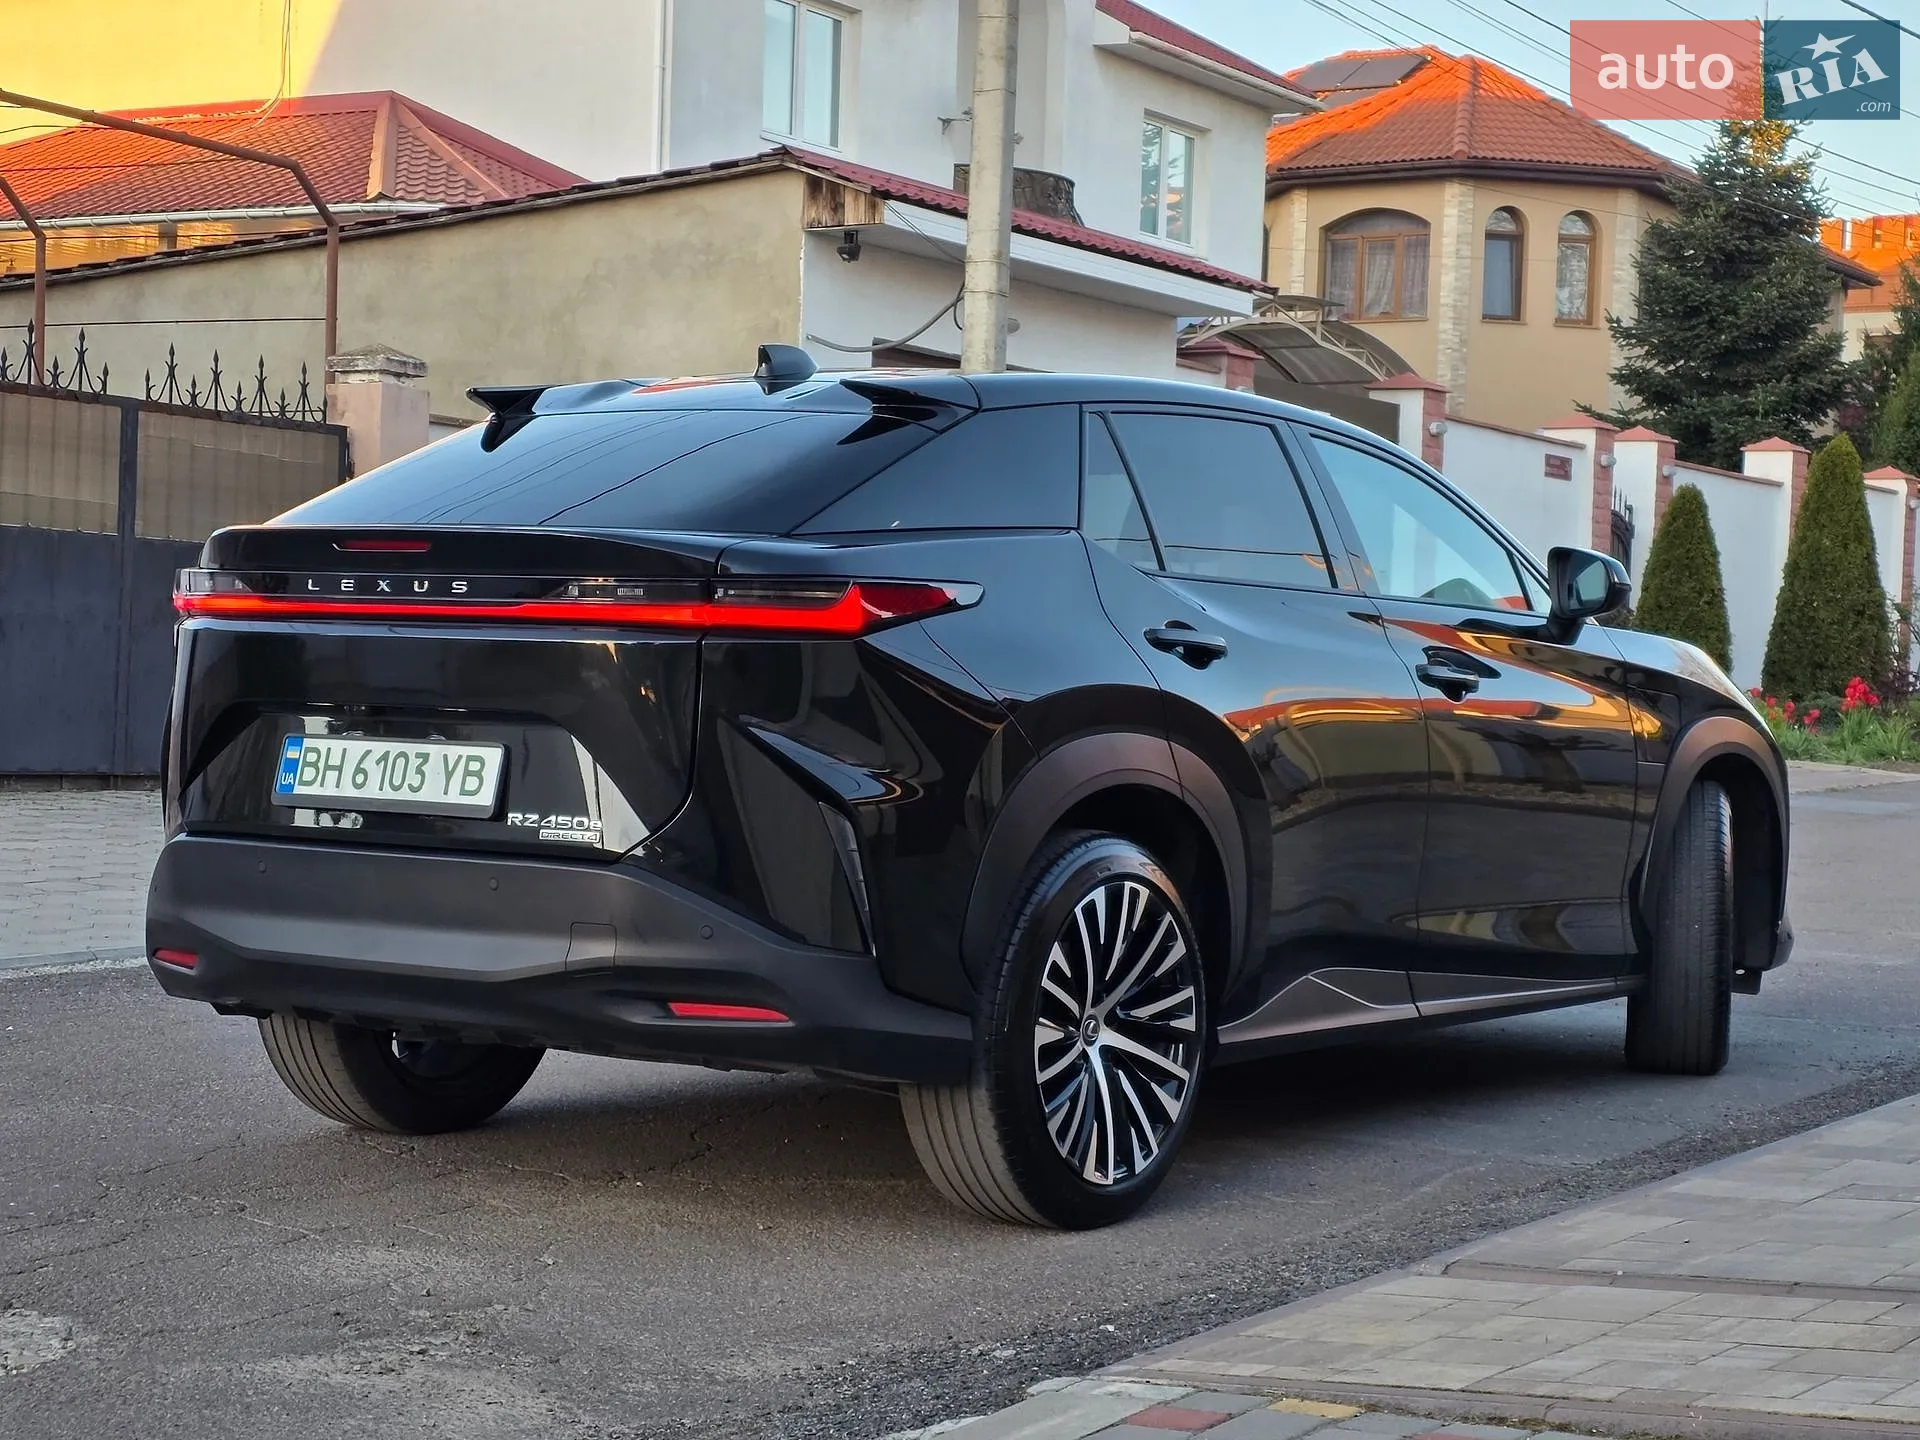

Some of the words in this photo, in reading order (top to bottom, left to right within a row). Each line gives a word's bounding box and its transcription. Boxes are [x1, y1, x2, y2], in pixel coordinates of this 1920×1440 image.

[306, 578, 469, 594] LEXUS
[281, 772, 294, 785] UA
[297, 746, 347, 789] BH
[351, 748, 429, 794] 6103
[441, 753, 486, 797] YB
